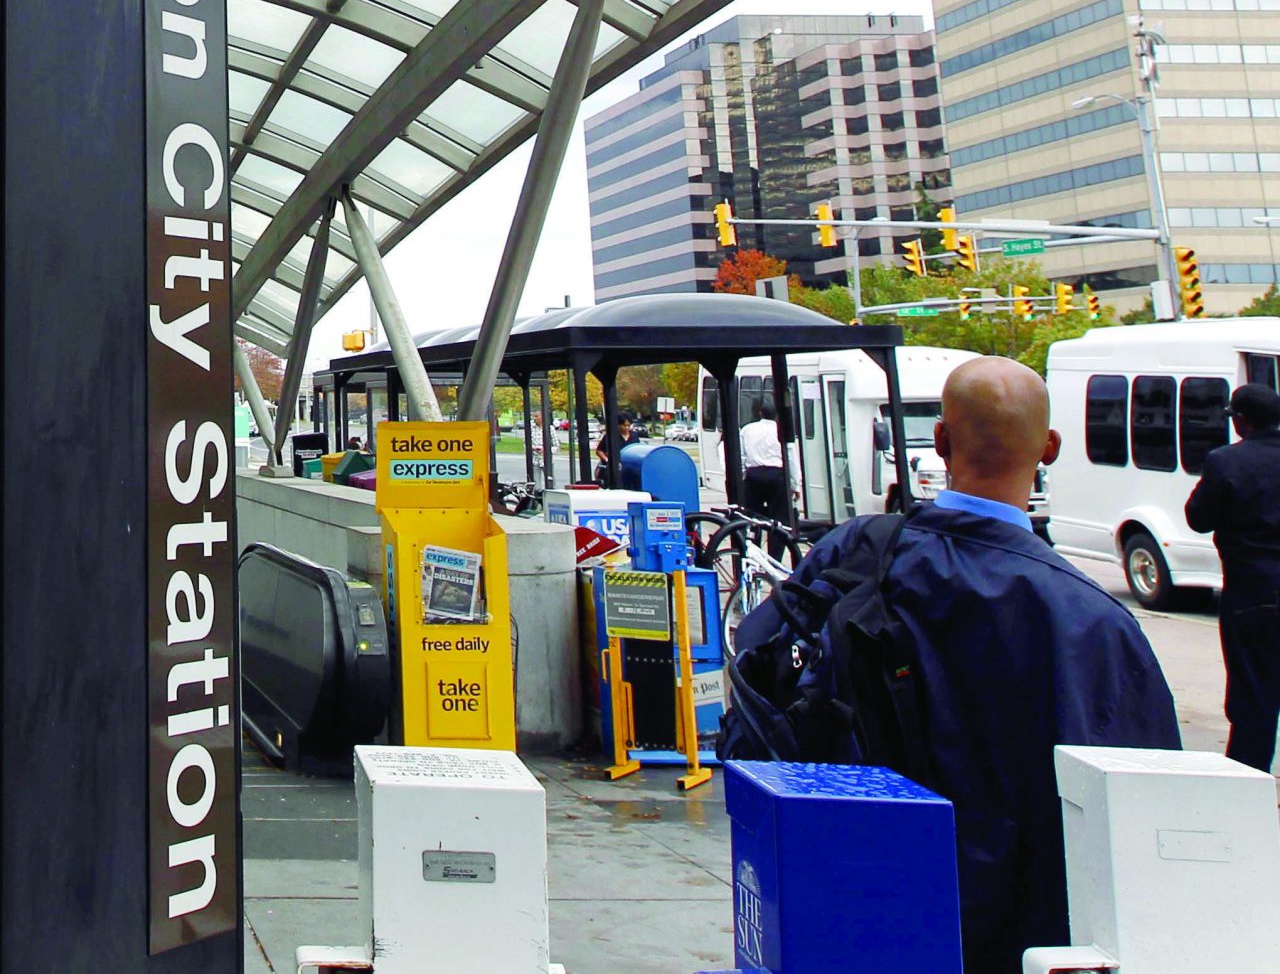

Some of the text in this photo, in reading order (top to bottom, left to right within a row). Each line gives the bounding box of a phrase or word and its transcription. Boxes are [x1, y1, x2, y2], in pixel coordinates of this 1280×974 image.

[149, 123, 224, 371] City
[390, 435, 474, 453] take one
[393, 463, 469, 478] express
[426, 552, 464, 566] express
[422, 637, 490, 653] free daily
[165, 420, 230, 919] Station
[438, 678, 481, 696] take
[700, 681, 720, 695] Post
[442, 698, 479, 712] one
[737, 881, 762, 931] THE
[738, 914, 763, 966] SUN
